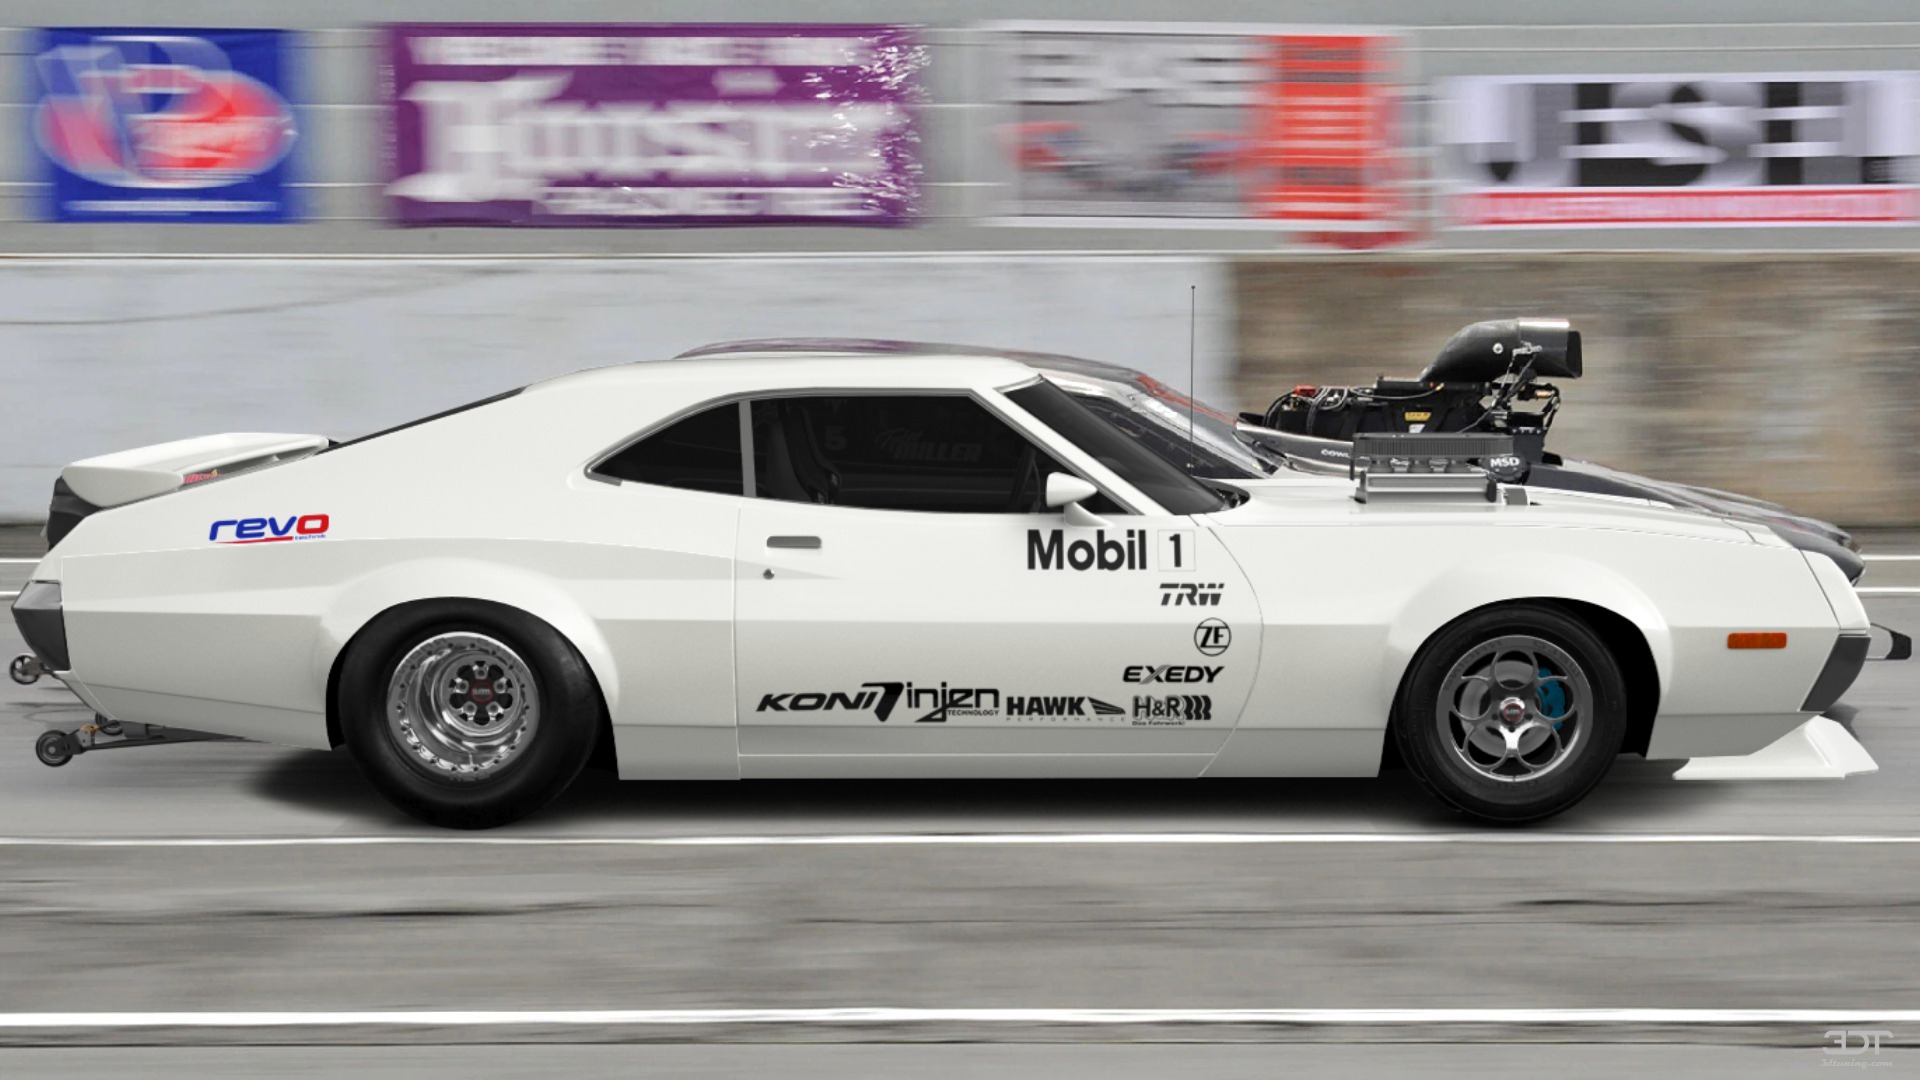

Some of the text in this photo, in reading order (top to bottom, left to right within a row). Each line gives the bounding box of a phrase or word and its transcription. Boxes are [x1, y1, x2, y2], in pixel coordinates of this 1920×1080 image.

[823, 425, 848, 451] 5
[893, 441, 983, 462] MILLER
[1490, 456, 1521, 468] MSD
[209, 513, 330, 541] revo
[1027, 529, 1182, 571] Mobil 1
[1159, 583, 1225, 606] TRW
[1196, 623, 1230, 651] ZF
[1123, 664, 1225, 685] EXEDY
[906, 681, 1000, 723] injen
[947, 709, 1000, 717] TECHNOLOGY
[1006, 696, 1086, 716] HAWK
[1132, 694, 1185, 721] H&R
